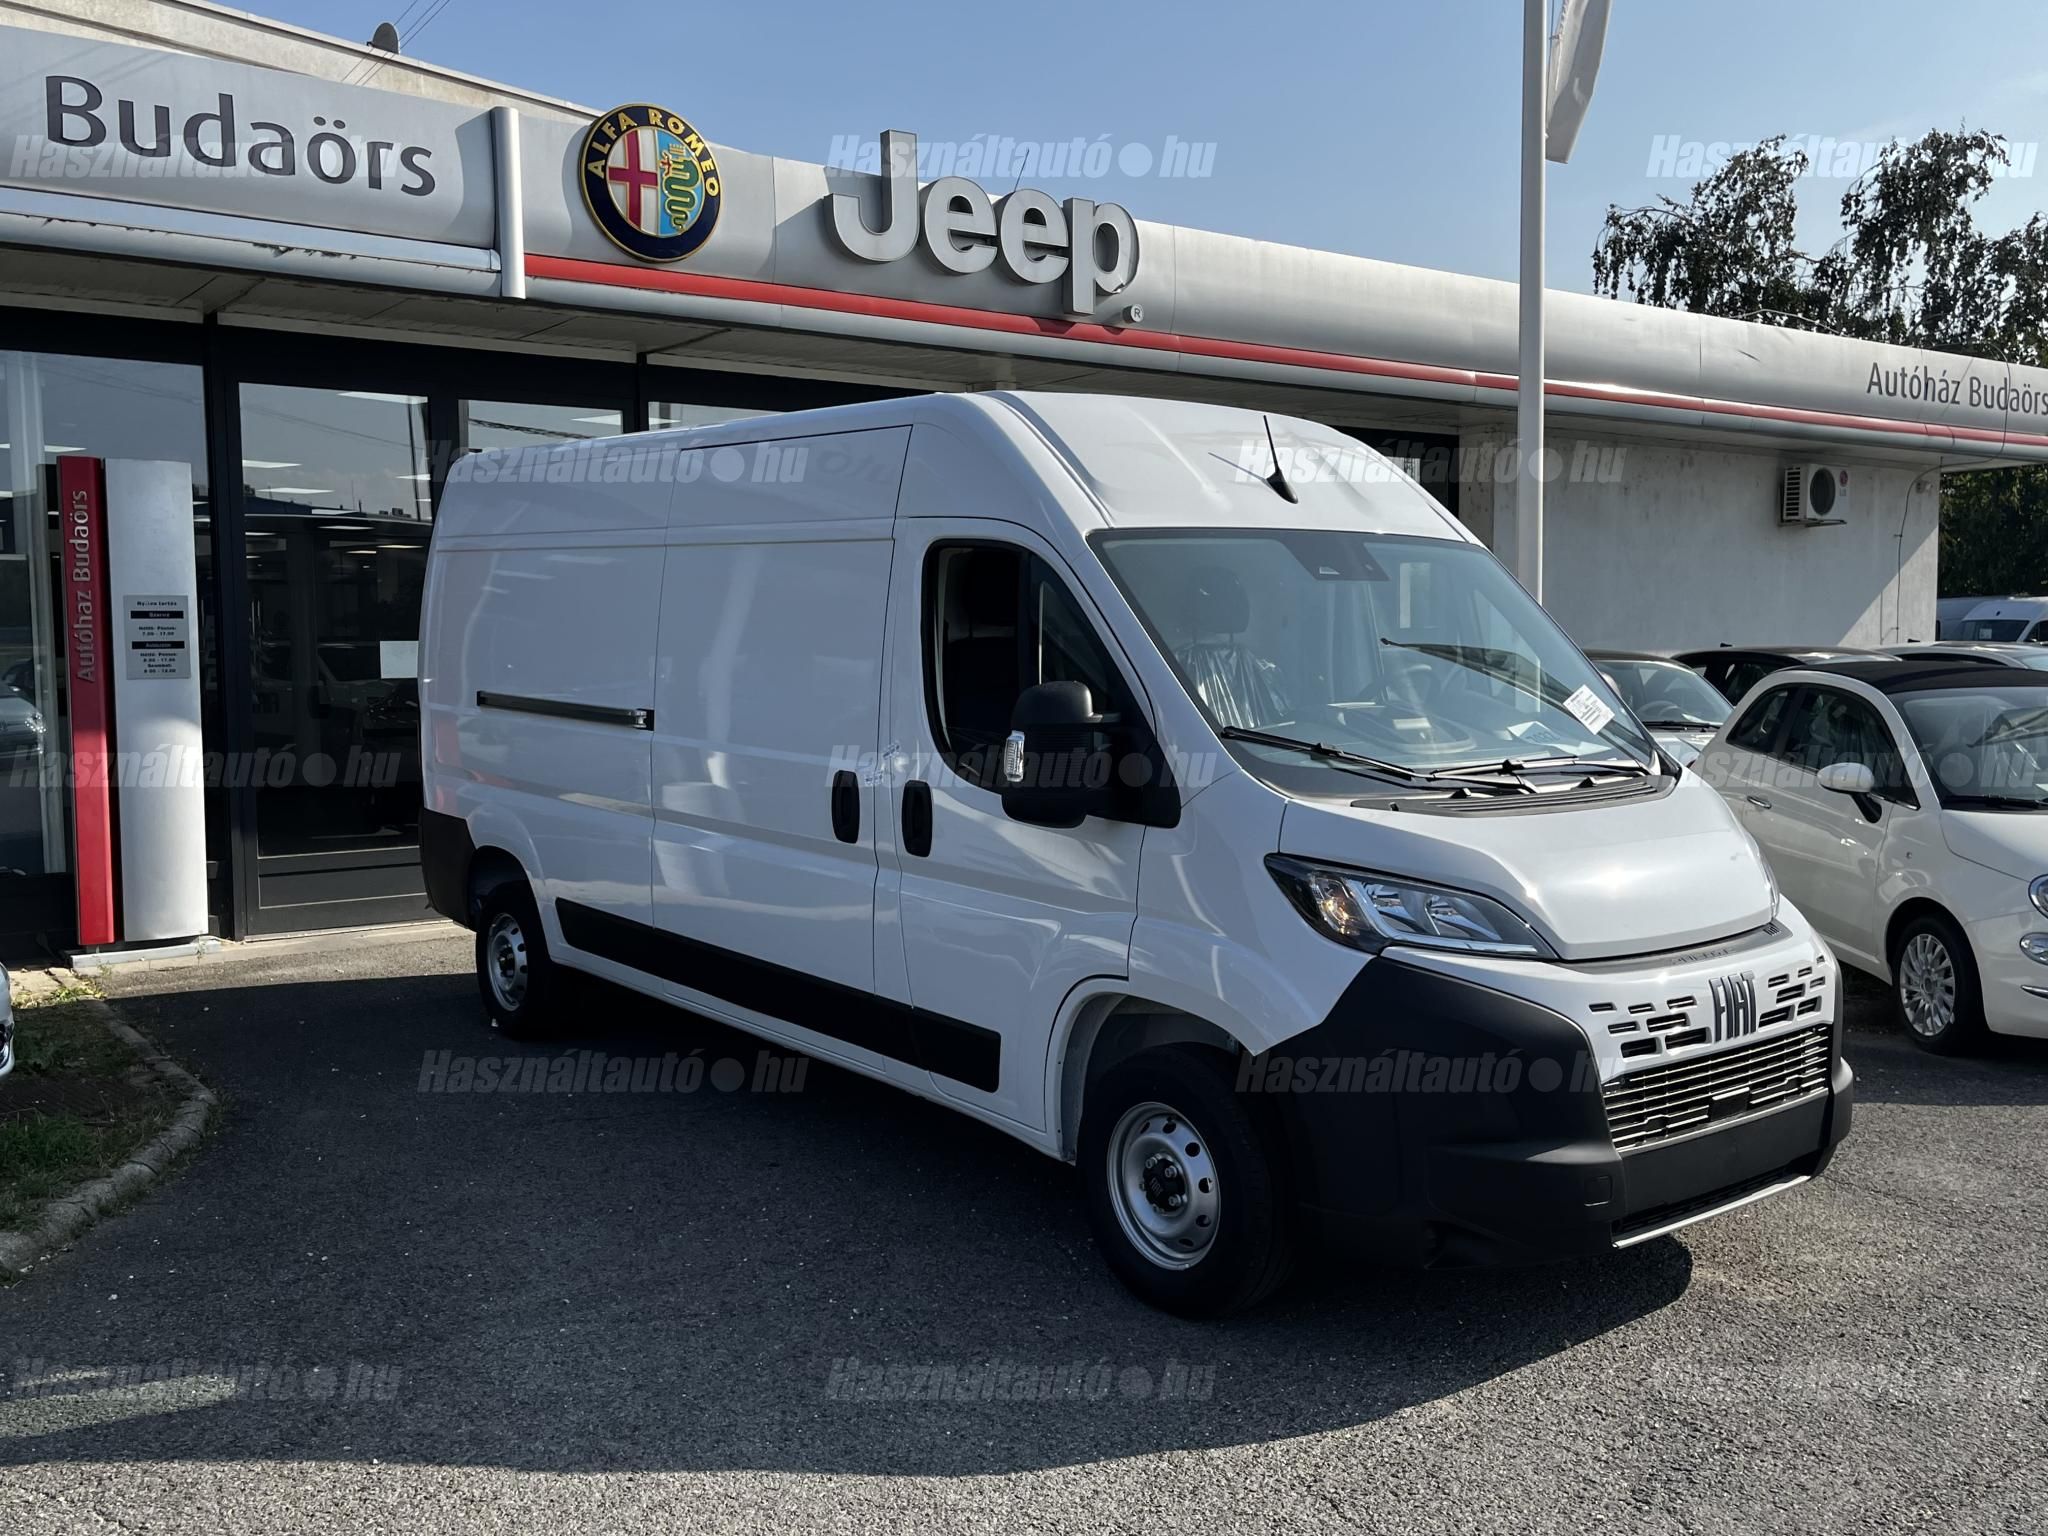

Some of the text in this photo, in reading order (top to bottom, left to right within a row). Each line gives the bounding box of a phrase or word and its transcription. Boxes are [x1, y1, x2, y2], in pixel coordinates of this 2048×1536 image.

[46, 75, 435, 196] Budaörs
[588, 108, 719, 197] ALFA ROMEO
[823, 129, 1139, 315] Jeep
[1867, 362, 2048, 416] Autóház Budaörs
[69, 490, 91, 582] Budaörs
[1708, 970, 1757, 1043] FIAT
